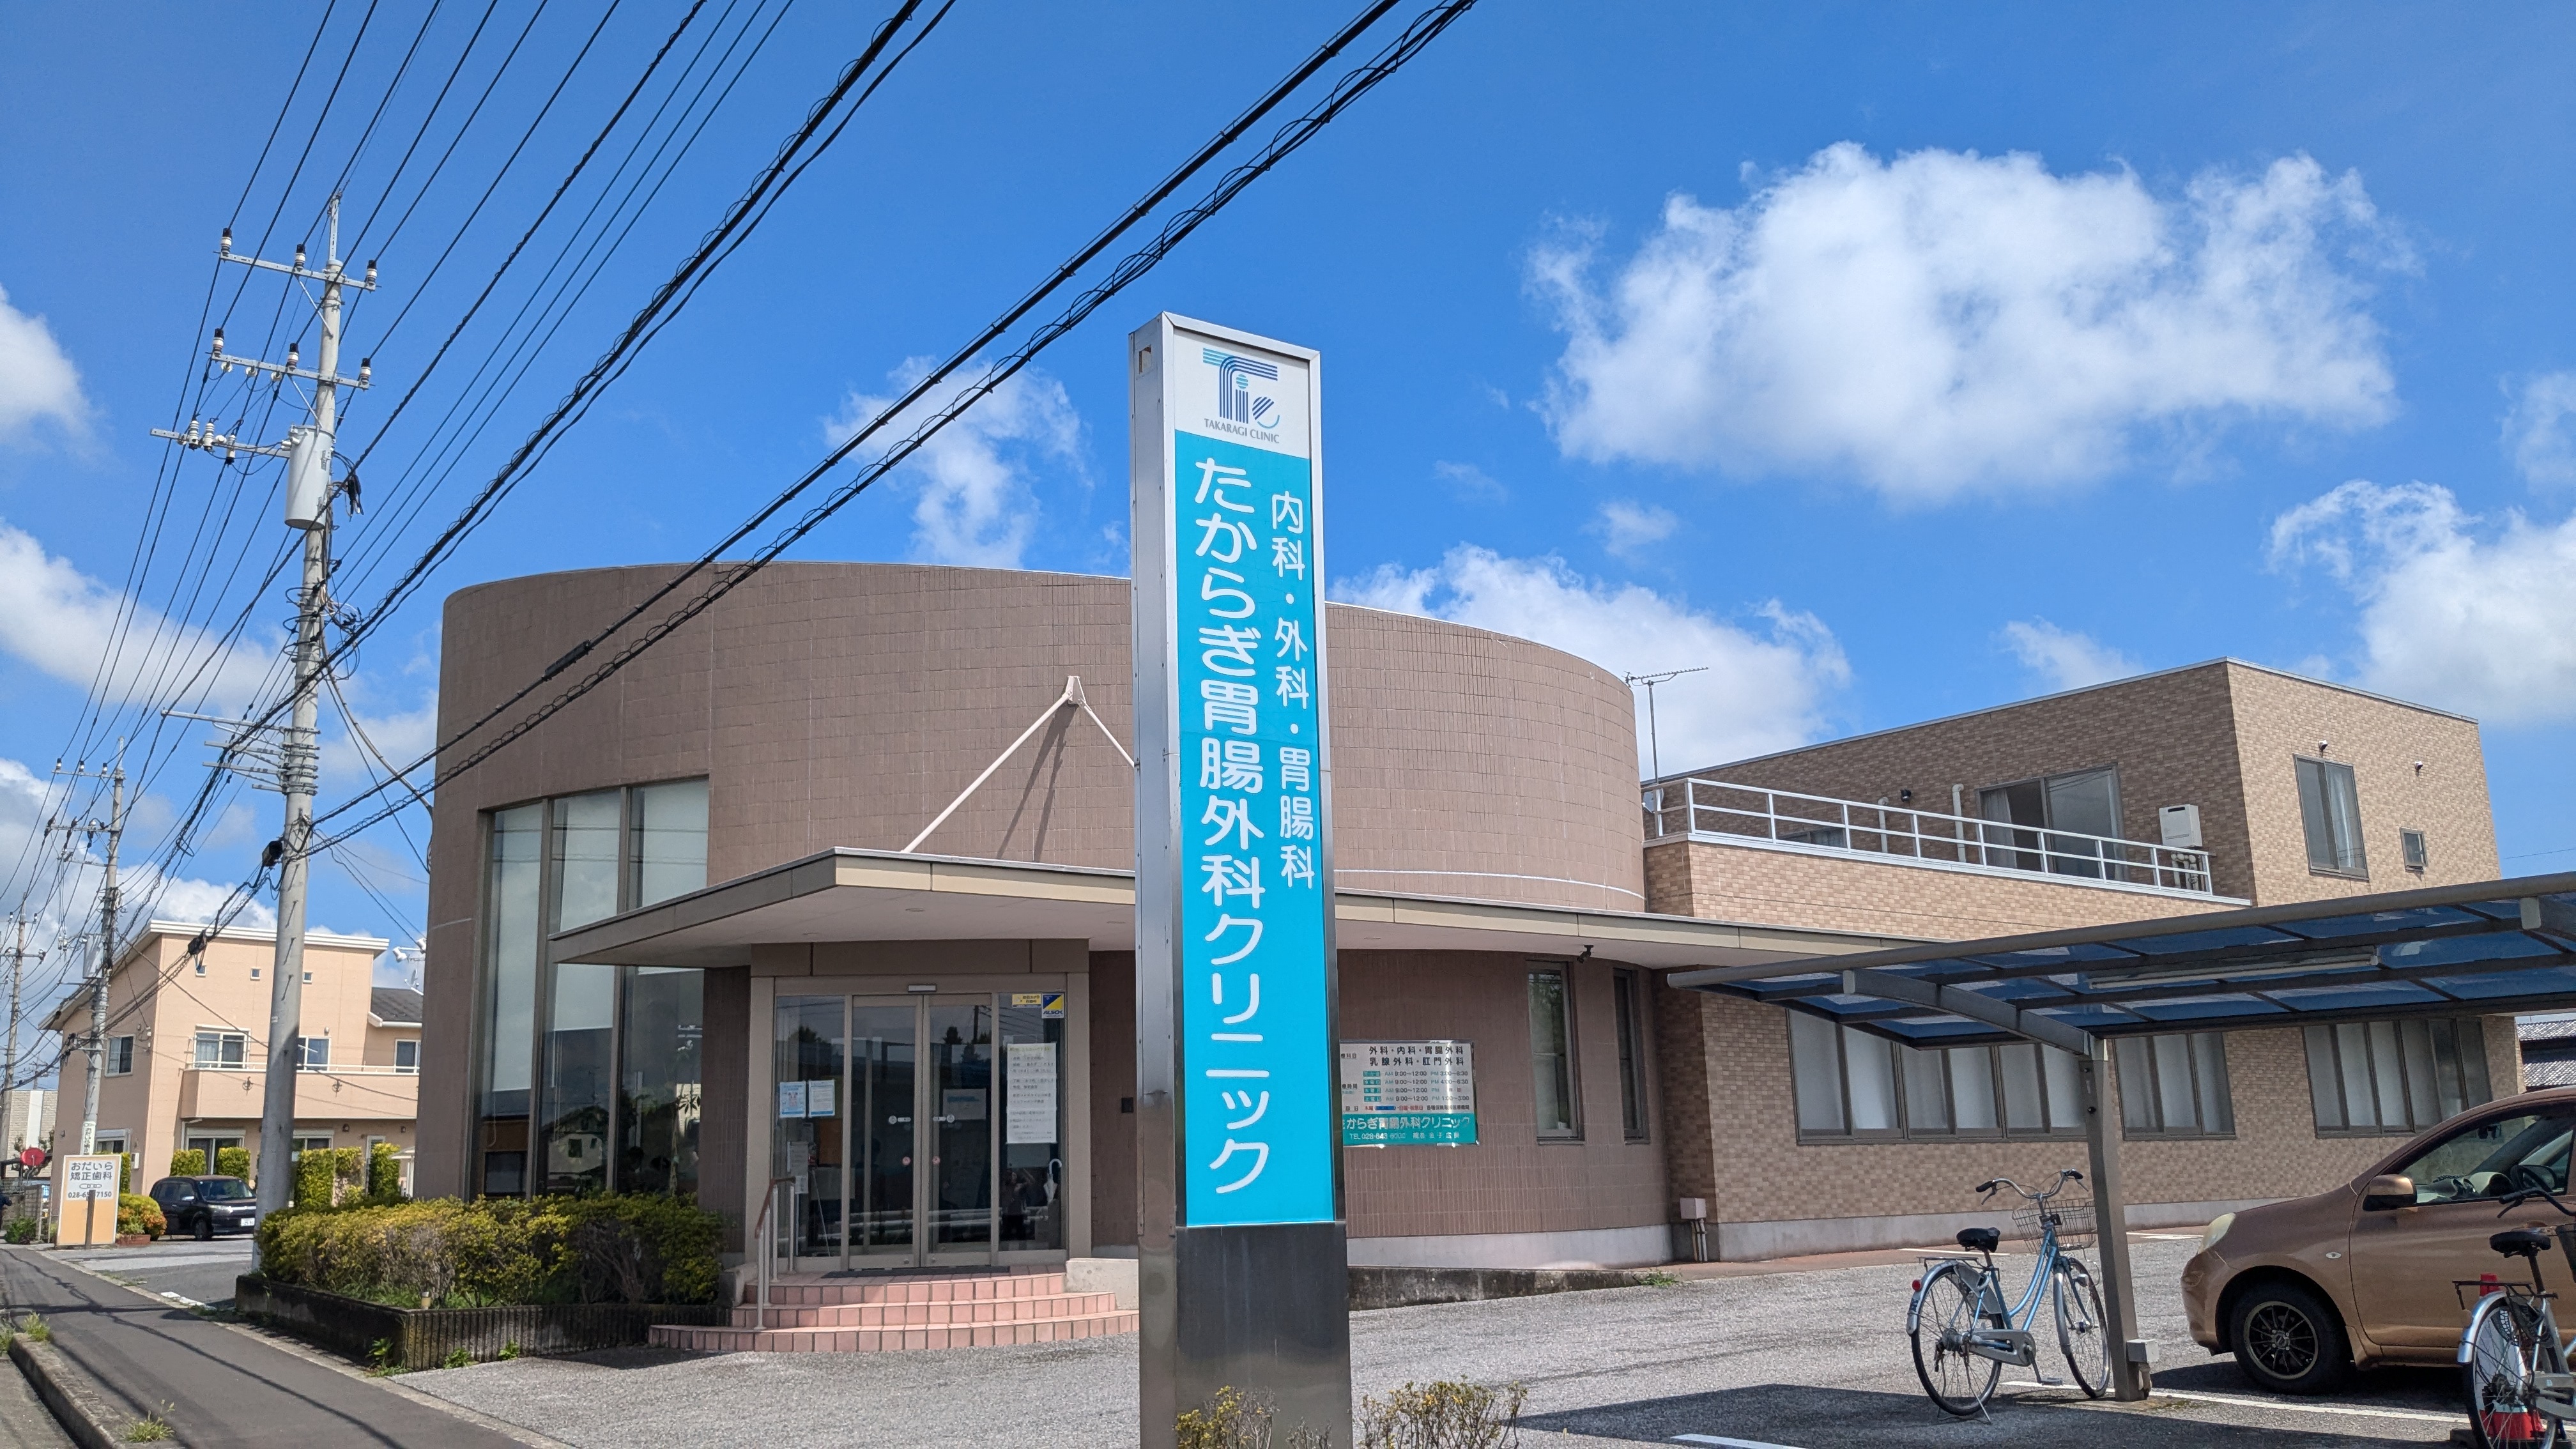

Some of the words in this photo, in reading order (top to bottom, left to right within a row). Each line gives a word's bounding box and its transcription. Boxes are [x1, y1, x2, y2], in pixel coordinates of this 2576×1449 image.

[1204, 418, 1248, 436] TAKARAGI
[1250, 429, 1280, 444] CLINIC
[1271, 490, 1315, 889] 内科・外科・胃腸科
[1193, 456, 1269, 1195] たからぎ胃腸外科クリニック
[70, 1171, 112, 1181] 矯正歯科
[71, 1162, 113, 1170] おだいら
